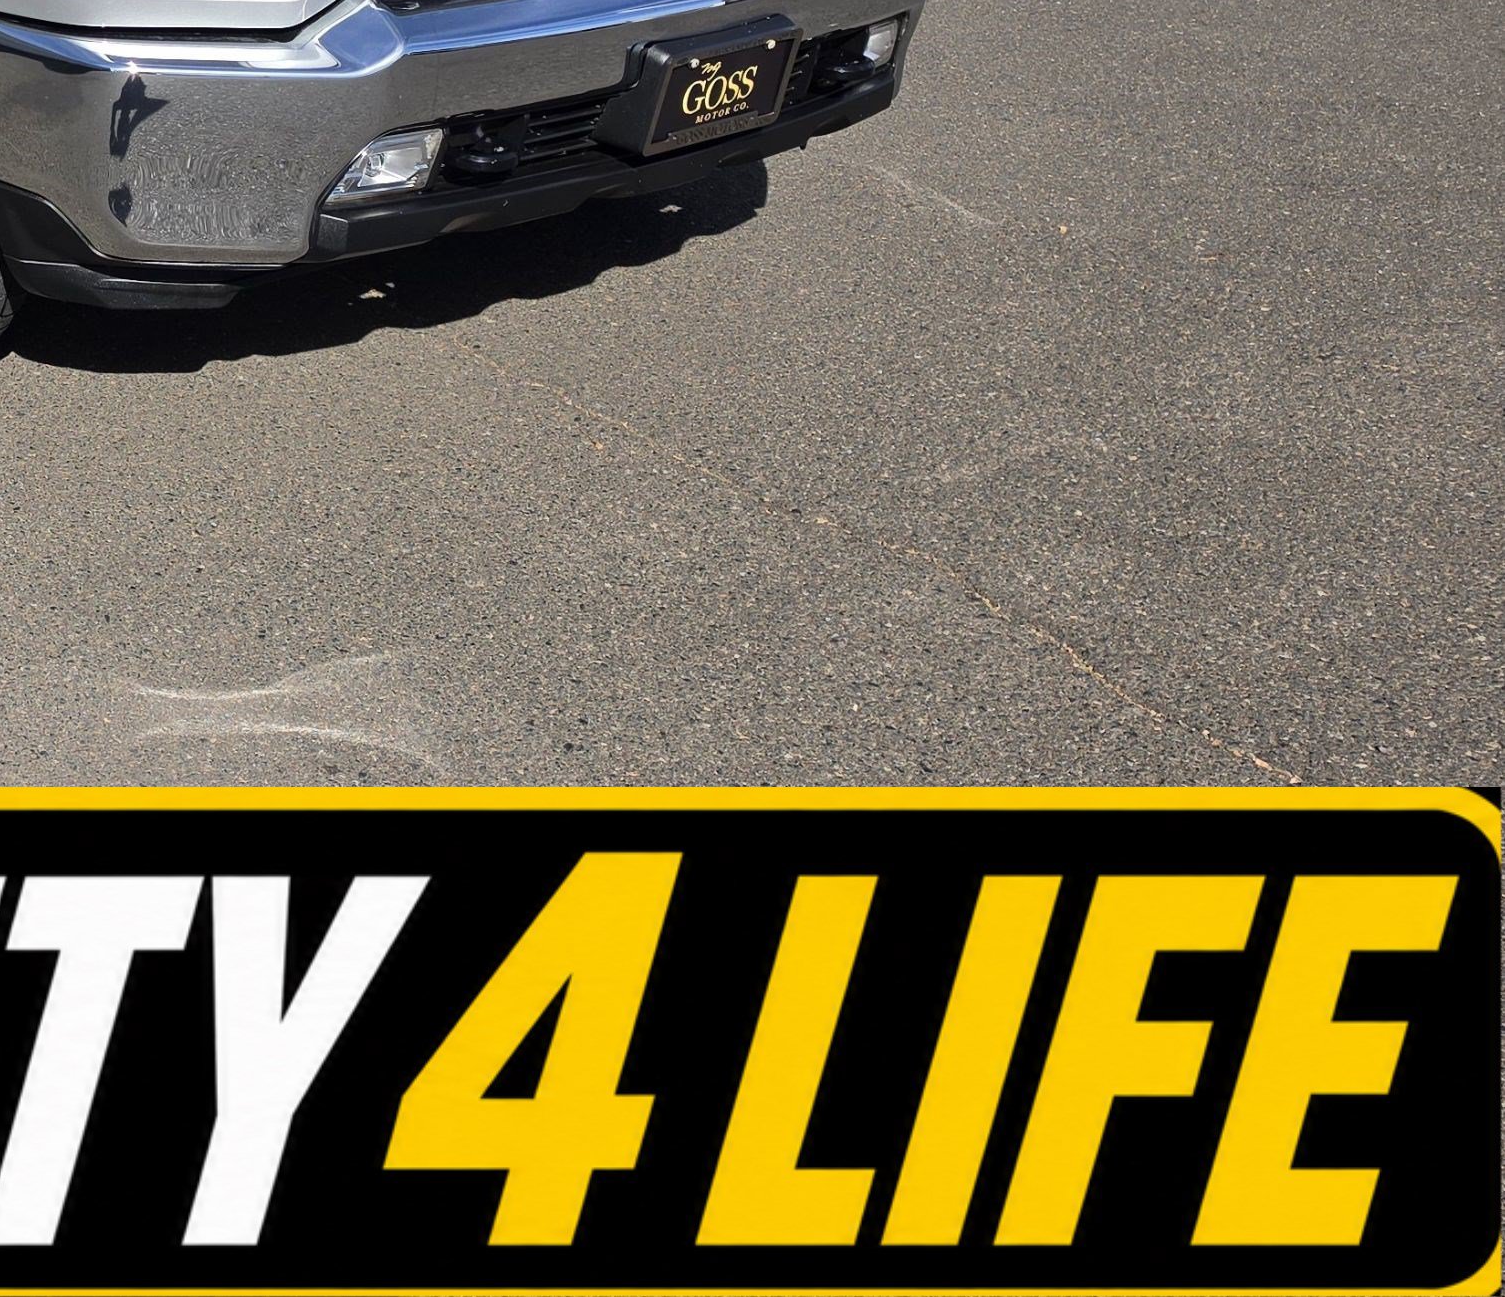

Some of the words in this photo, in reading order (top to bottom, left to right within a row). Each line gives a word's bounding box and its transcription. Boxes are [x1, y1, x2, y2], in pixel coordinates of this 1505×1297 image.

[682, 65, 759, 115] GOSS
[695, 107, 731, 124] MOTOR
[733, 101, 750, 113] CO.
